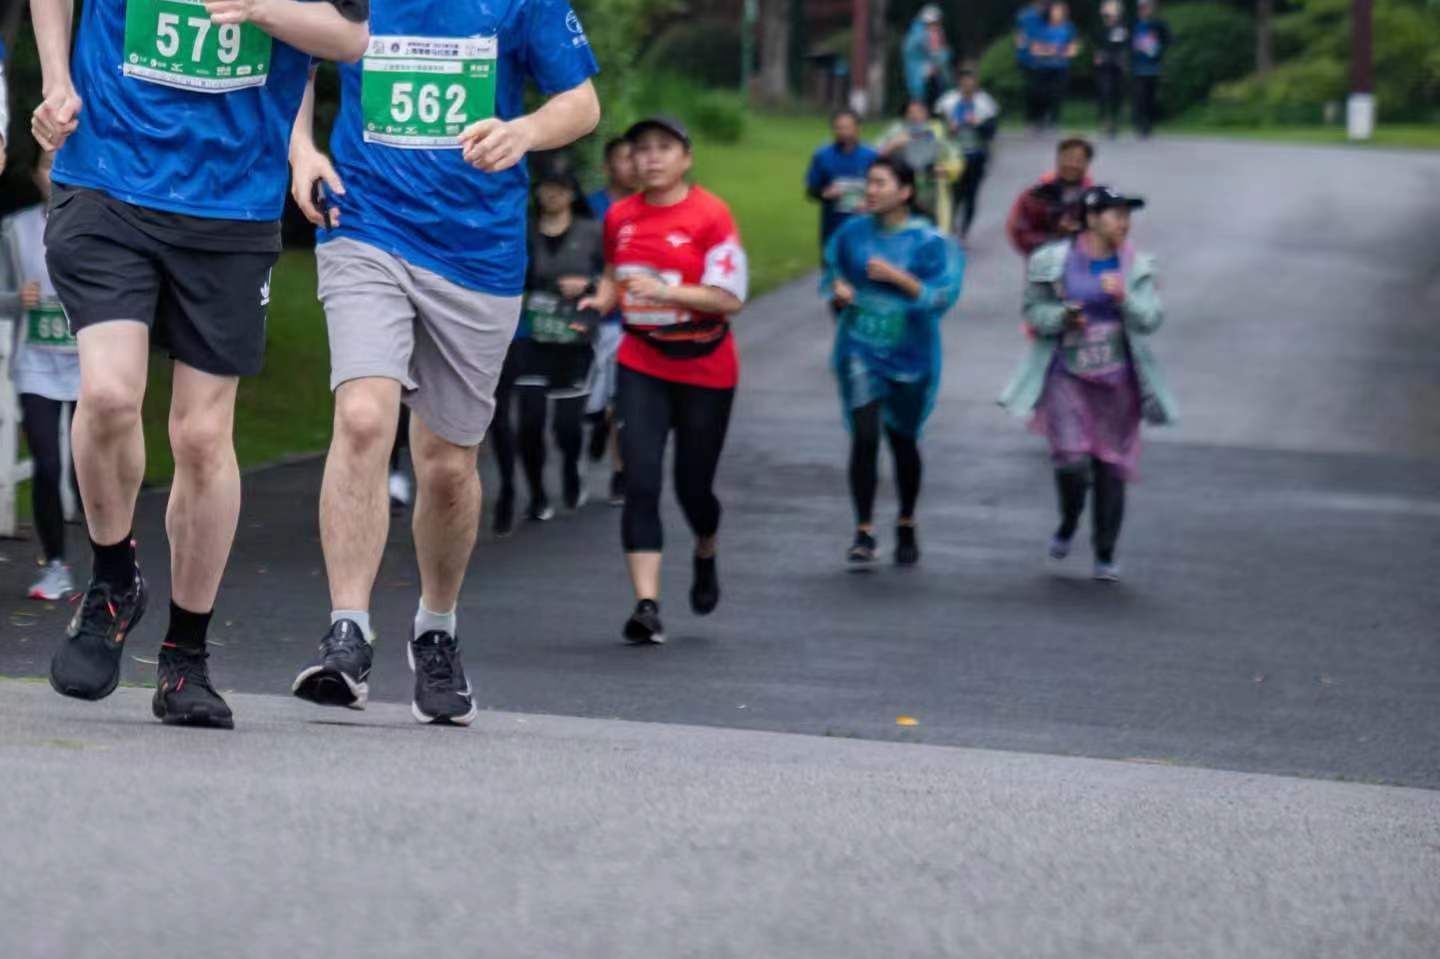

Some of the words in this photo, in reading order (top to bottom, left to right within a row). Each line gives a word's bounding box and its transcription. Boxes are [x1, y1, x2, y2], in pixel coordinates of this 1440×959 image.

[155, 12, 241, 64] 579
[390, 82, 467, 123] 562
[38, 316, 73, 338] 69
